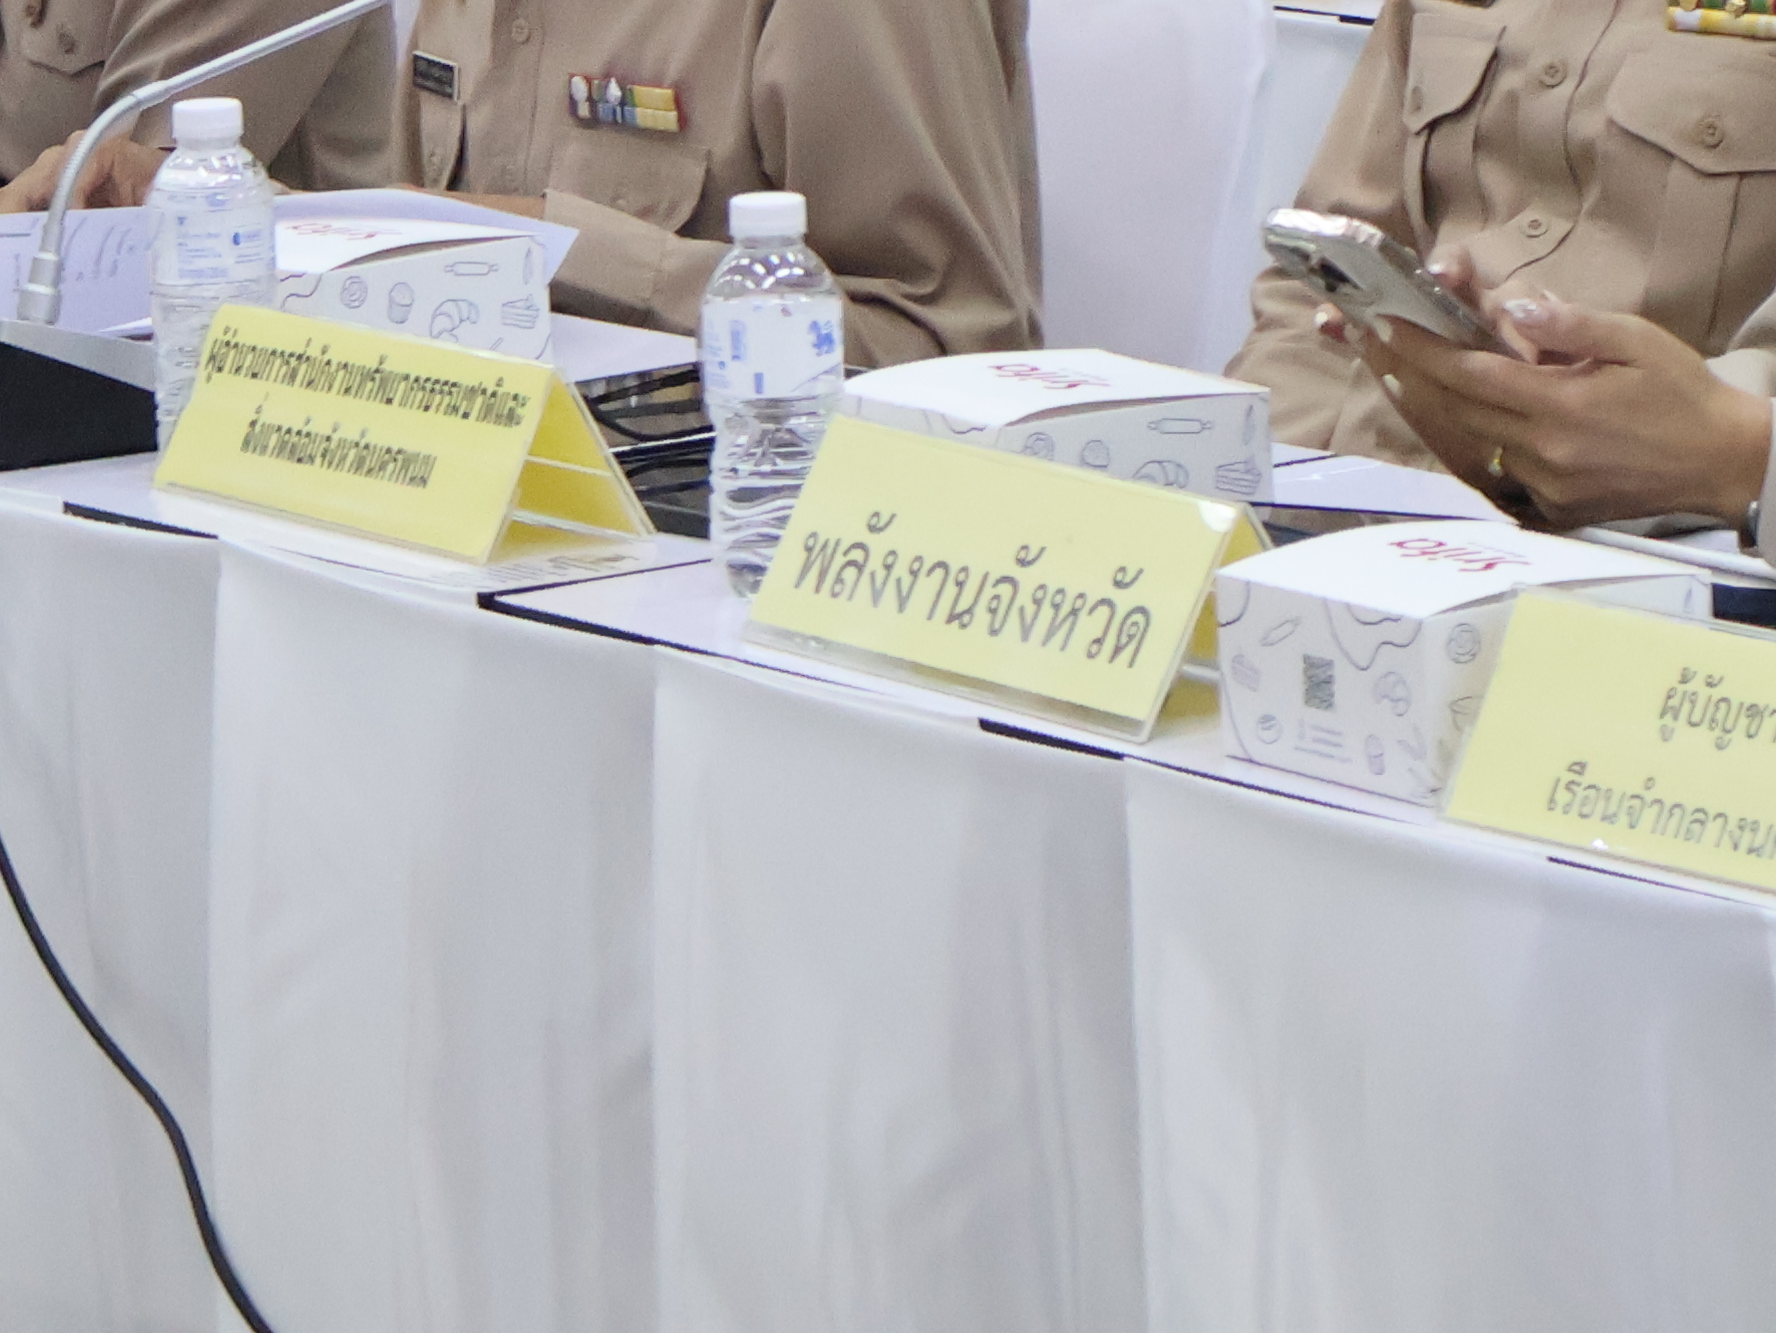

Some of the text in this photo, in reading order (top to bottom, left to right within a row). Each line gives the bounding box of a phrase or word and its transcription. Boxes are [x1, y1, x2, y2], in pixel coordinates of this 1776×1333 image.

[793, 510, 1152, 670] พลังงานจังหวัด
